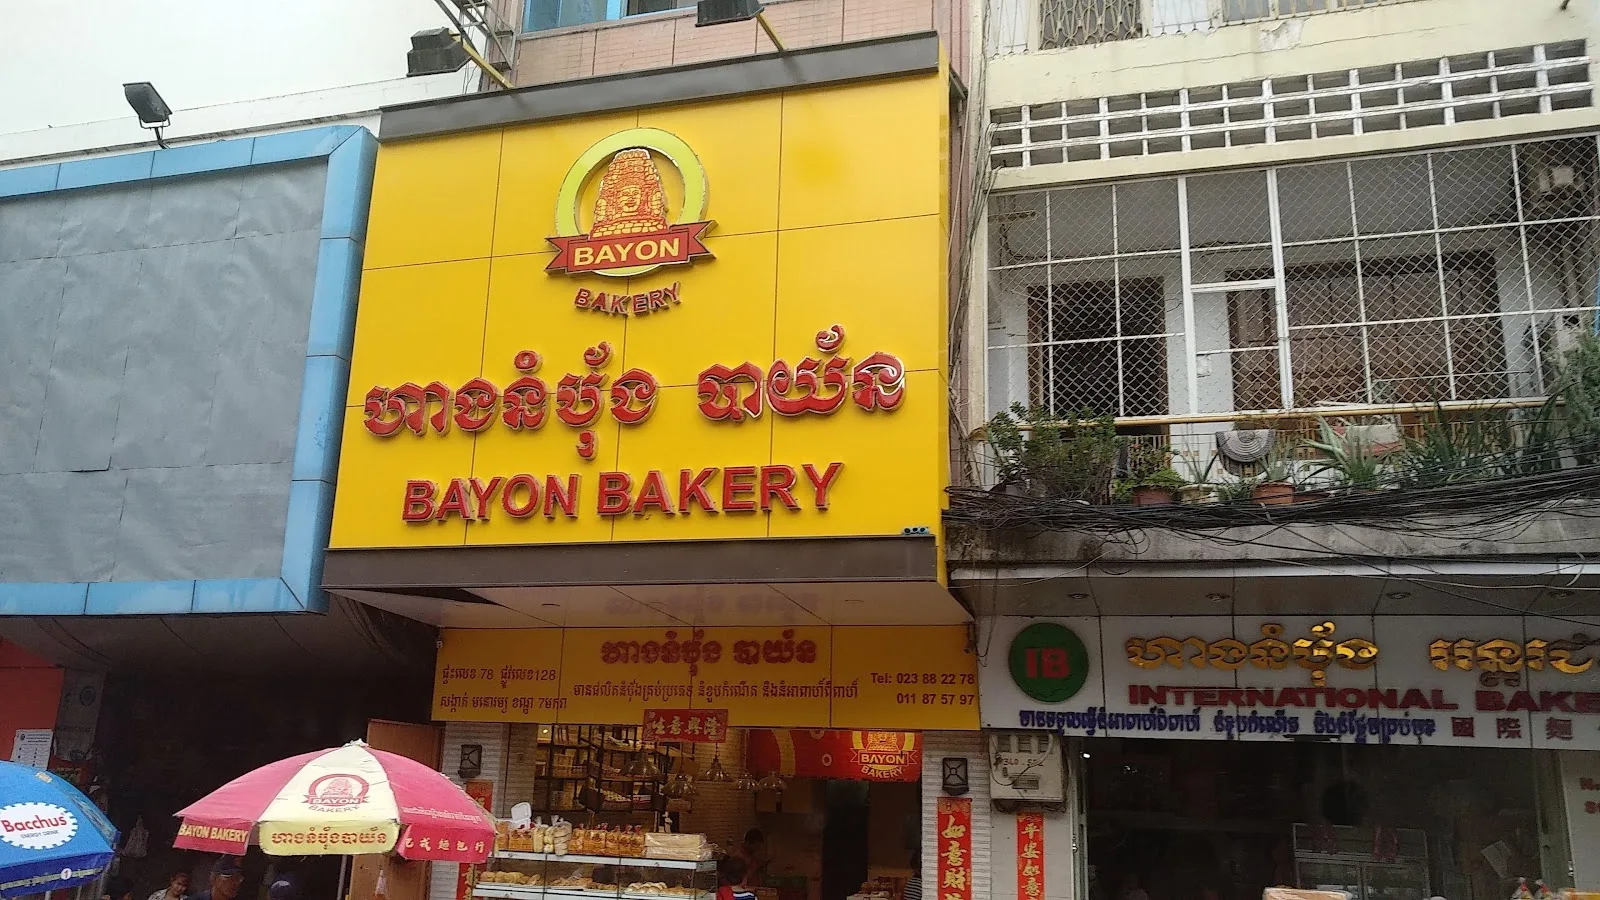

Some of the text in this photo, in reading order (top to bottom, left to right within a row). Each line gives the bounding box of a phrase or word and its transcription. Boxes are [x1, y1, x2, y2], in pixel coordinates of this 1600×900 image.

[574, 238, 680, 266] BAYON
[574, 280, 682, 316] BAKERY
[402, 462, 844, 522] BAYON BAKERY
[1026, 647, 1070, 679] IB
[480, 668, 494, 680] 78
[871, 673, 975, 685] Tel: 023 88 22 78
[896, 693, 975, 705] 011 87 57 97
[1128, 684, 1459, 710] INTERNATIONAL
[1451, 716, 1600, 740] 國際麵
[861, 753, 905, 765] BAYON
[861, 765, 903, 779] BAKERY
[309, 805, 360, 813] BAKERY
[2, 815, 68, 832] Bacchus
[20, 829, 59, 839] ENERGY DRINK
[178, 824, 248, 843] BAYON BAKERY
[1021, 822, 1041, 900] 平安如意
